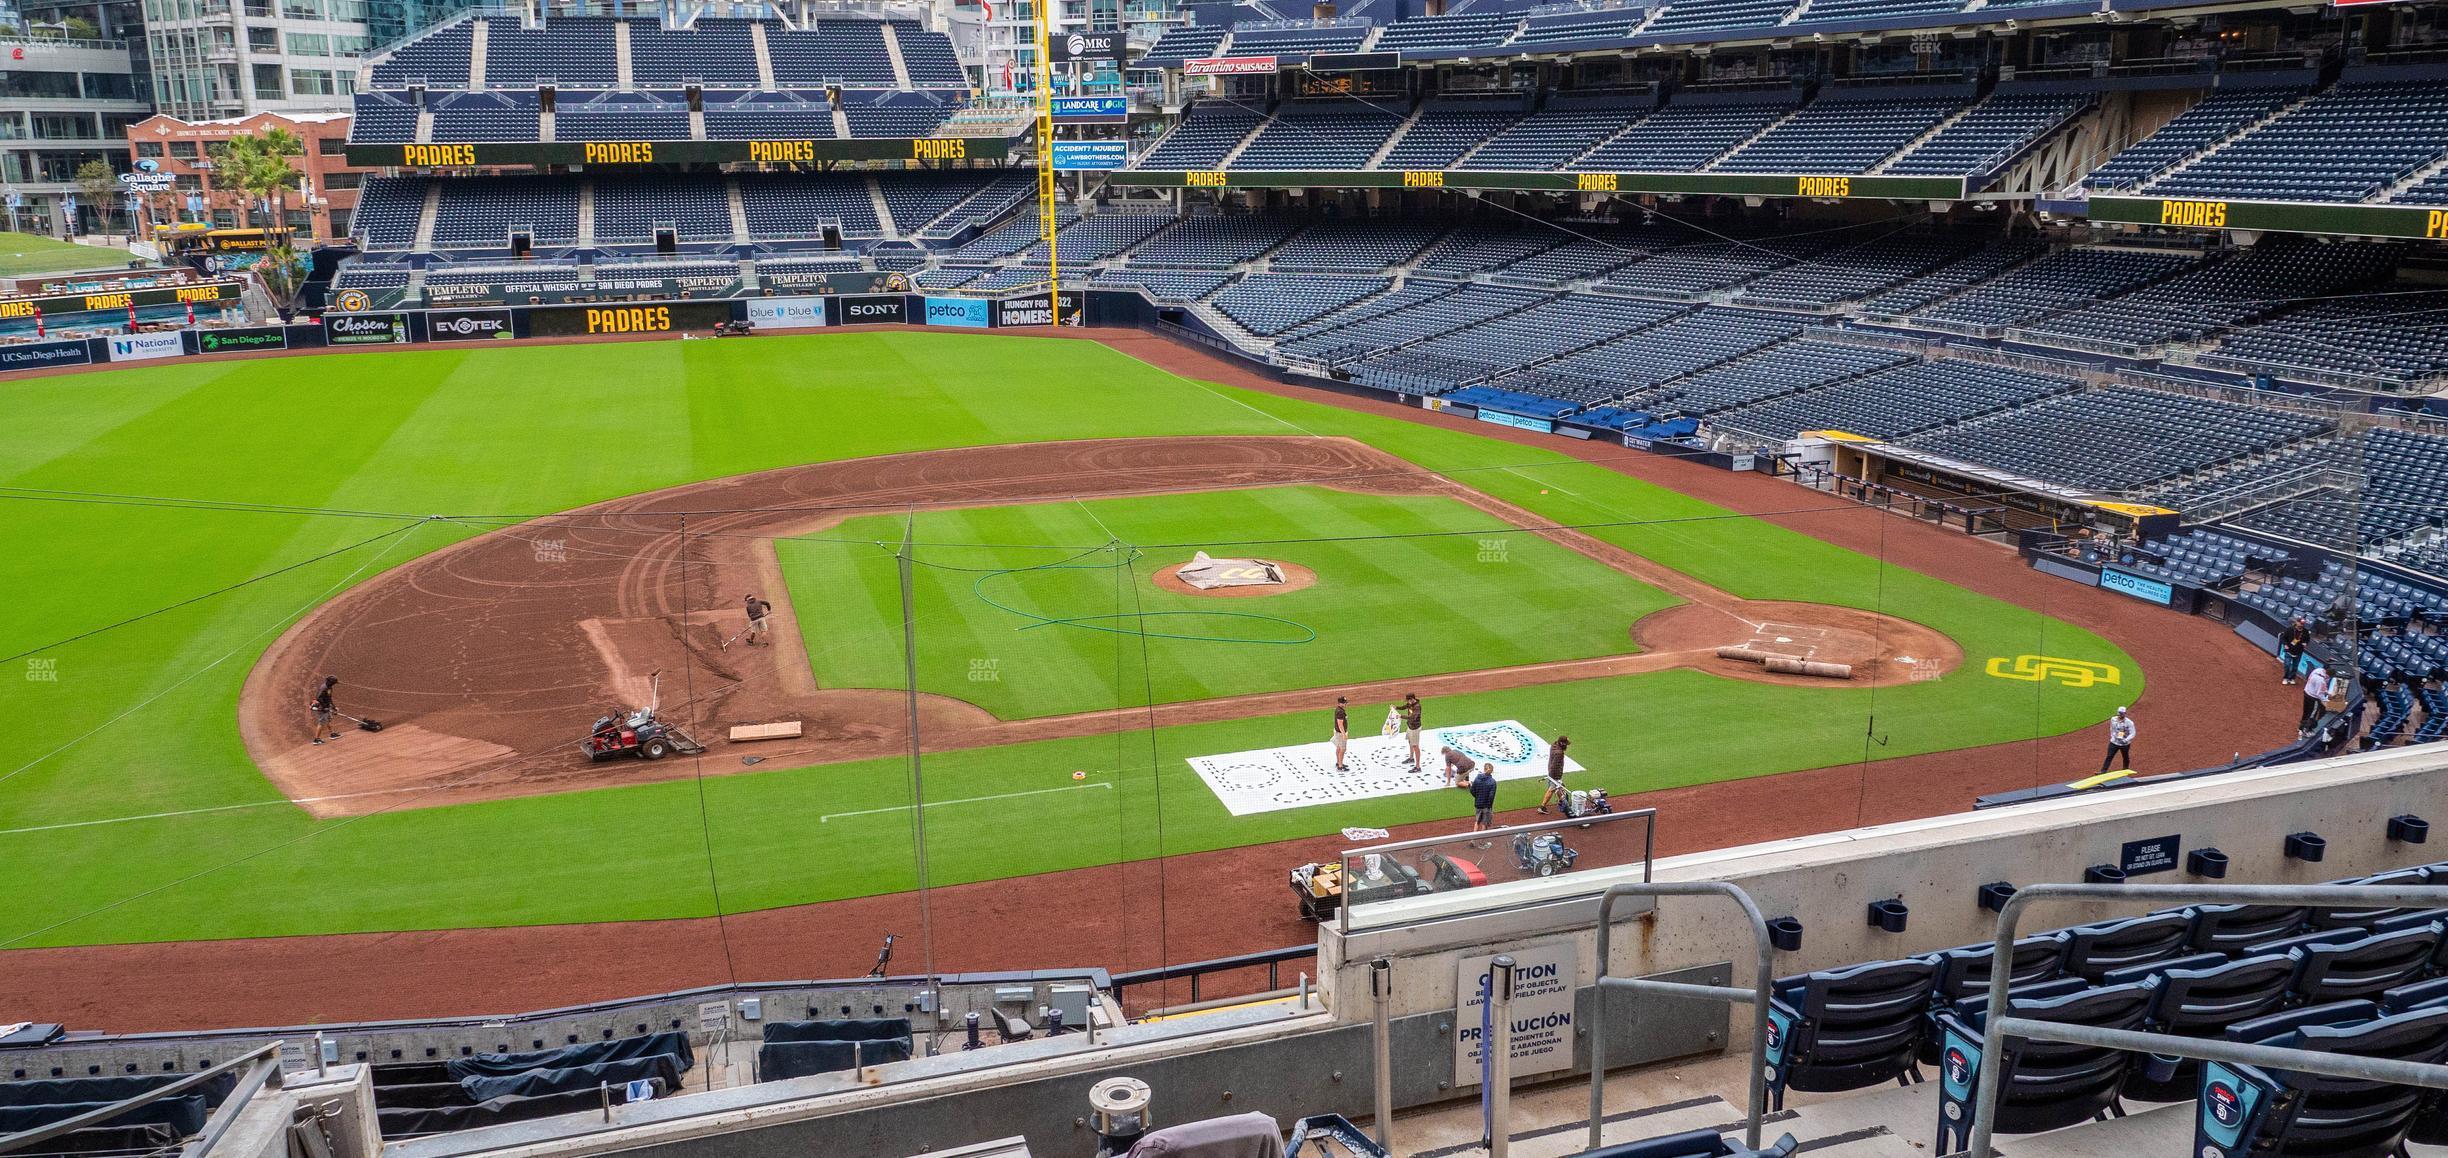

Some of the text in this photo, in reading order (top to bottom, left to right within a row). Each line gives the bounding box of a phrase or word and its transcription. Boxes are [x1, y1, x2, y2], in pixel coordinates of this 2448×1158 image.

[1084, 38, 1111, 49] MRC
[1187, 60, 1274, 73] Tarantino SAUSAGES
[1062, 100, 1099, 111] LANDCARE
[404, 144, 476, 166] PADRES
[586, 142, 652, 163] PADRES
[750, 141, 814, 162] PADRES
[913, 140, 965, 159] PADRES
[120, 173, 176, 184] Gallagher
[1186, 172, 1226, 186] PADRES
[1404, 171, 1443, 187] PADRES
[1578, 173, 1617, 191] PADRES
[130, 183, 170, 192] Square
[1798, 177, 1849, 196] PADRES
[2162, 200, 2226, 227] PADRES
[231, 240, 259, 248] BALLAST
[676, 278, 734, 288] TEMPLETON
[770, 274, 827, 284] TEMPLETON
[427, 285, 490, 296] TEMPLETON
[505, 284, 542, 293] OFFICIAL
[543, 282, 580, 292] WHISKEY
[598, 281, 614, 290] SAN
[614, 280, 635, 290] DIEGO
[636, 280, 663, 289] PADRES
[176, 286, 220, 302] PADRES
[84, 294, 132, 310] PADRES
[1004, 300, 1048, 309] HUNGRY FOR
[1058, 296, 1072, 308] 322
[750, 308, 774, 318] blue
[788, 306, 812, 316] blue
[850, 304, 899, 316] SONY
[930, 304, 966, 318] petco
[586, 306, 670, 334] PADRES
[1002, 310, 1052, 325] HOMERS
[332, 316, 389, 332] Chosen
[136, 337, 178, 348] National
[222, 336, 238, 344] San
[240, 335, 264, 344] Diego
[2, 348, 82, 362] UC San Diego Health
[1478, 410, 1496, 420] petco
[1514, 417, 1532, 426] petco
[2104, 572, 2135, 588] petco
[2141, 844, 2160, 854] PLEASE
[1527, 979, 1558, 988] OBJECTS
[1549, 986, 1566, 994] PLAY
[1517, 1038, 1562, 1050] ABANDONAN
[1530, 1047, 1553, 1055] JUEGO
